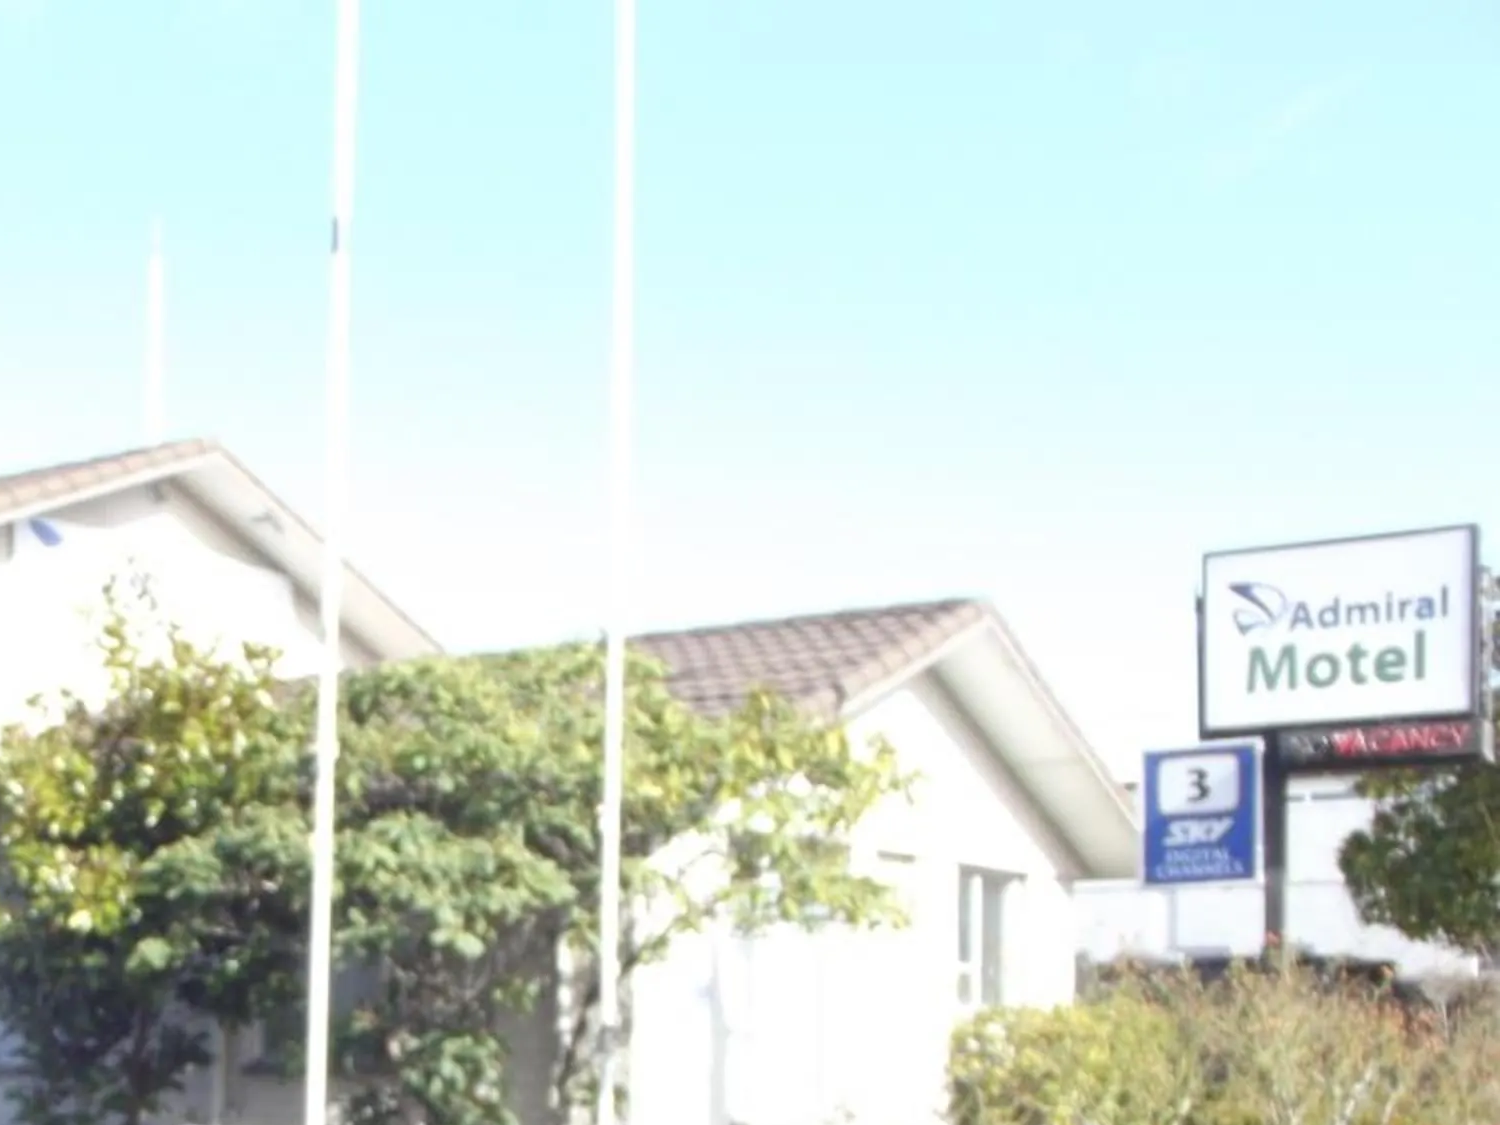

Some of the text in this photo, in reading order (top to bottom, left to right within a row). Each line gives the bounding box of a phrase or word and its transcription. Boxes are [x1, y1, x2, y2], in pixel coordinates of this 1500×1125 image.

[1288, 584, 1449, 632] Admiral
[1246, 629, 1427, 694] Motel
[1185, 767, 1212, 803] 3
[1162, 816, 1235, 847] SKY
